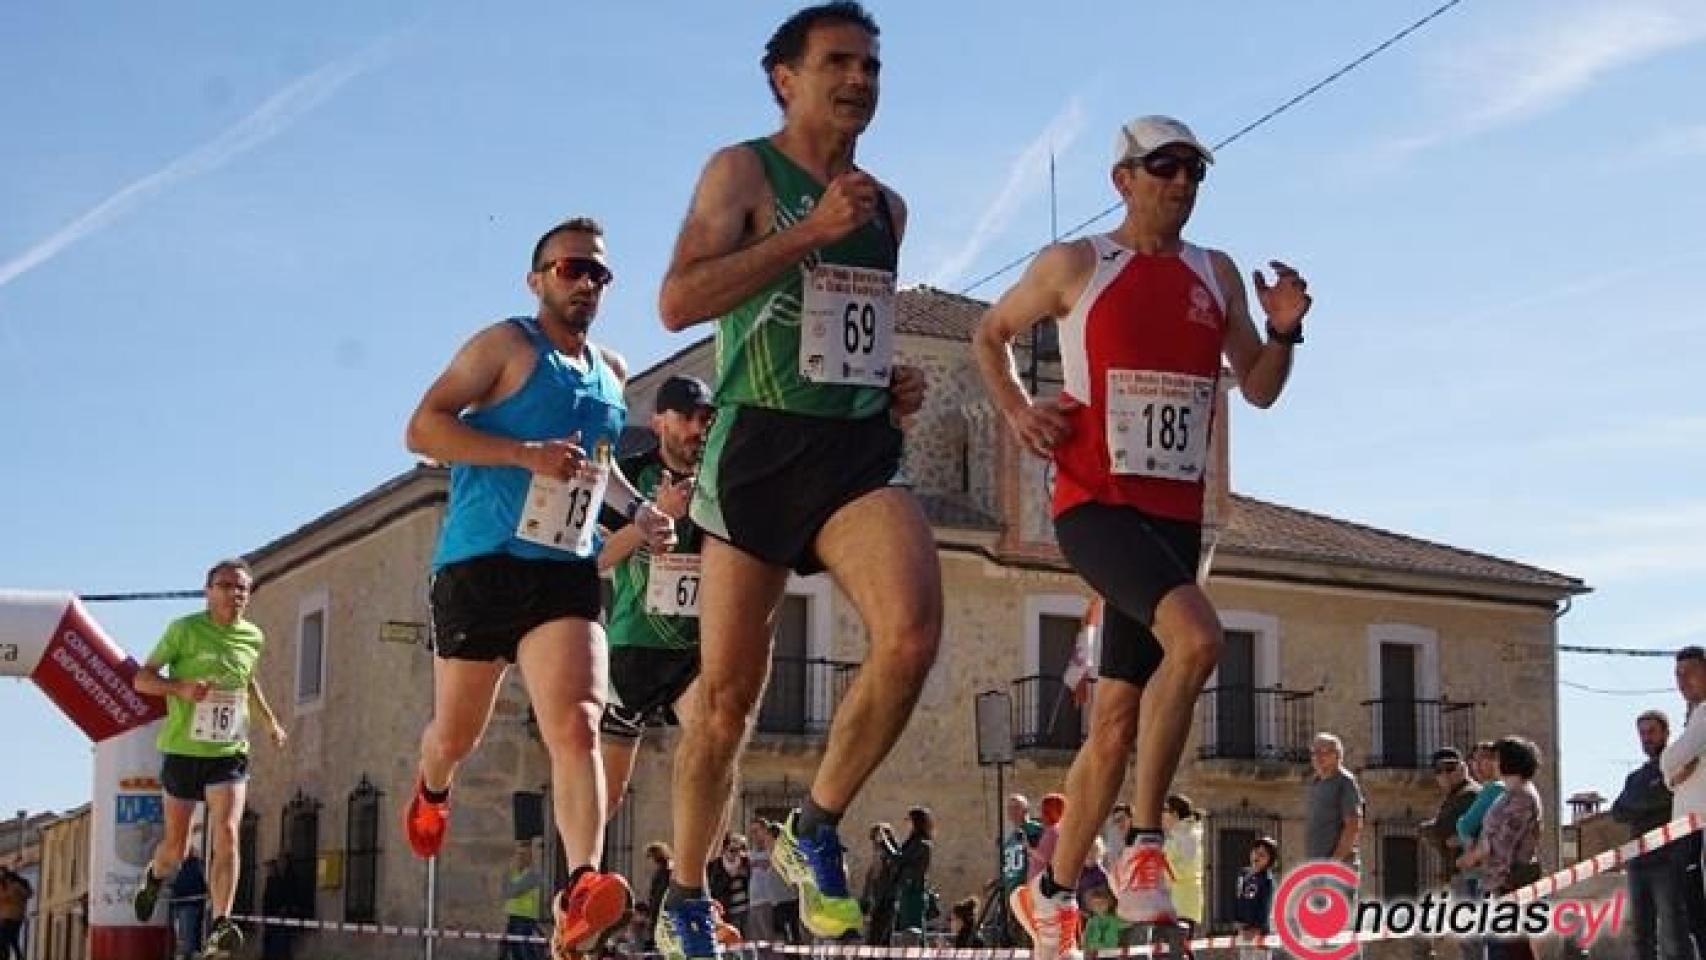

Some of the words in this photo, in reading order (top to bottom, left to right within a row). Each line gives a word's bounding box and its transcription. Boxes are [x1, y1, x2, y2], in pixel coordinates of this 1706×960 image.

[845, 302, 876, 354] 69
[1142, 403, 1191, 452] 185
[565, 486, 592, 530] 13
[676, 575, 700, 607] 67
[63, 631, 91, 658] CON
